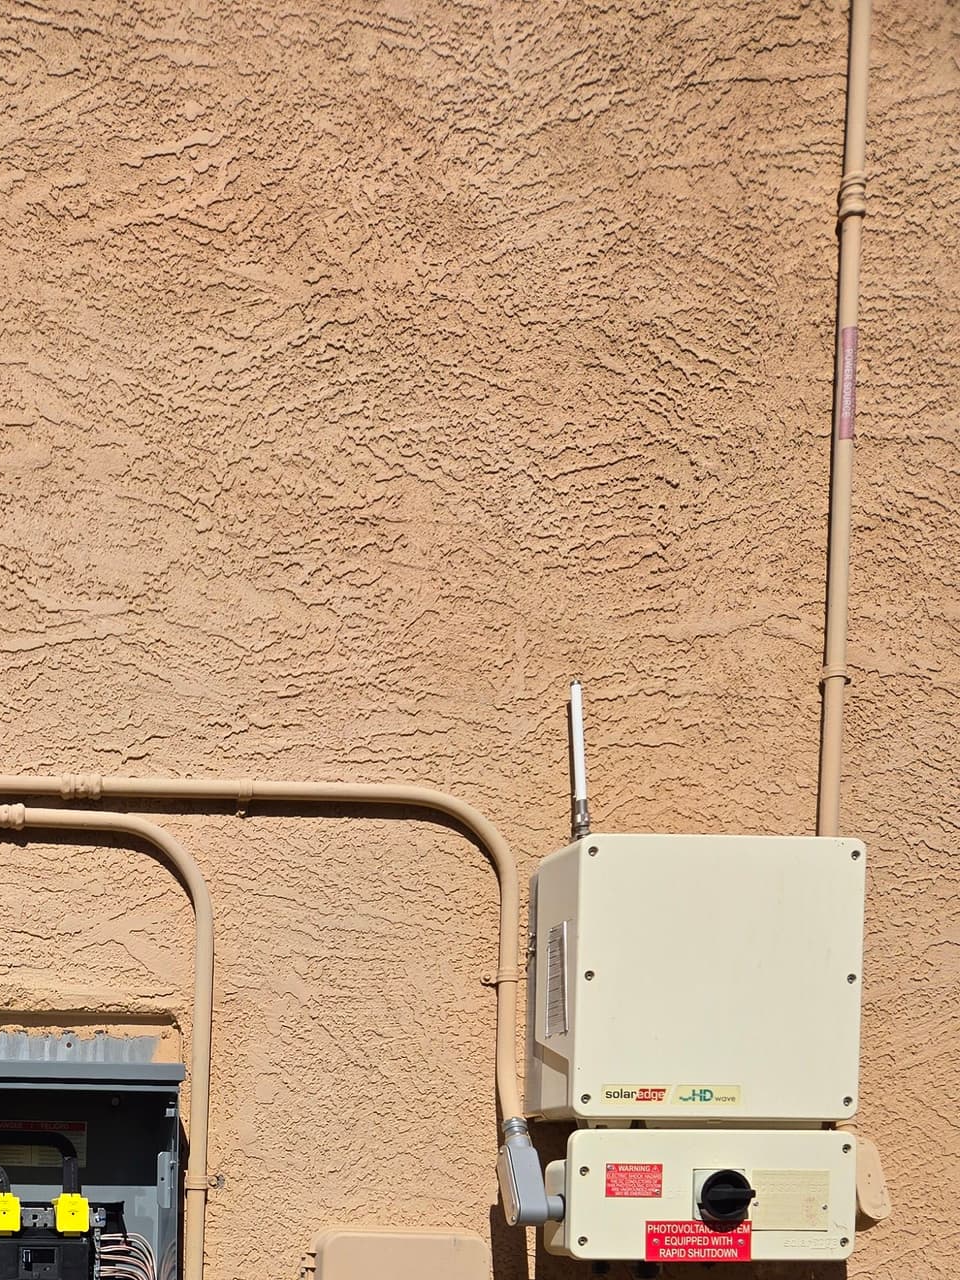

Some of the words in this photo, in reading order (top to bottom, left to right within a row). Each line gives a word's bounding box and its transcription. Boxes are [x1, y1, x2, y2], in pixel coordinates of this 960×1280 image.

[605, 1088, 665, 1101] solaredge
[664, 1236, 709, 1246] EQUIPPED
[710, 1236, 733, 1246] WITH
[659, 1248, 686, 1258] RAPID
[687, 1248, 738, 1258] SHUTDOWN
